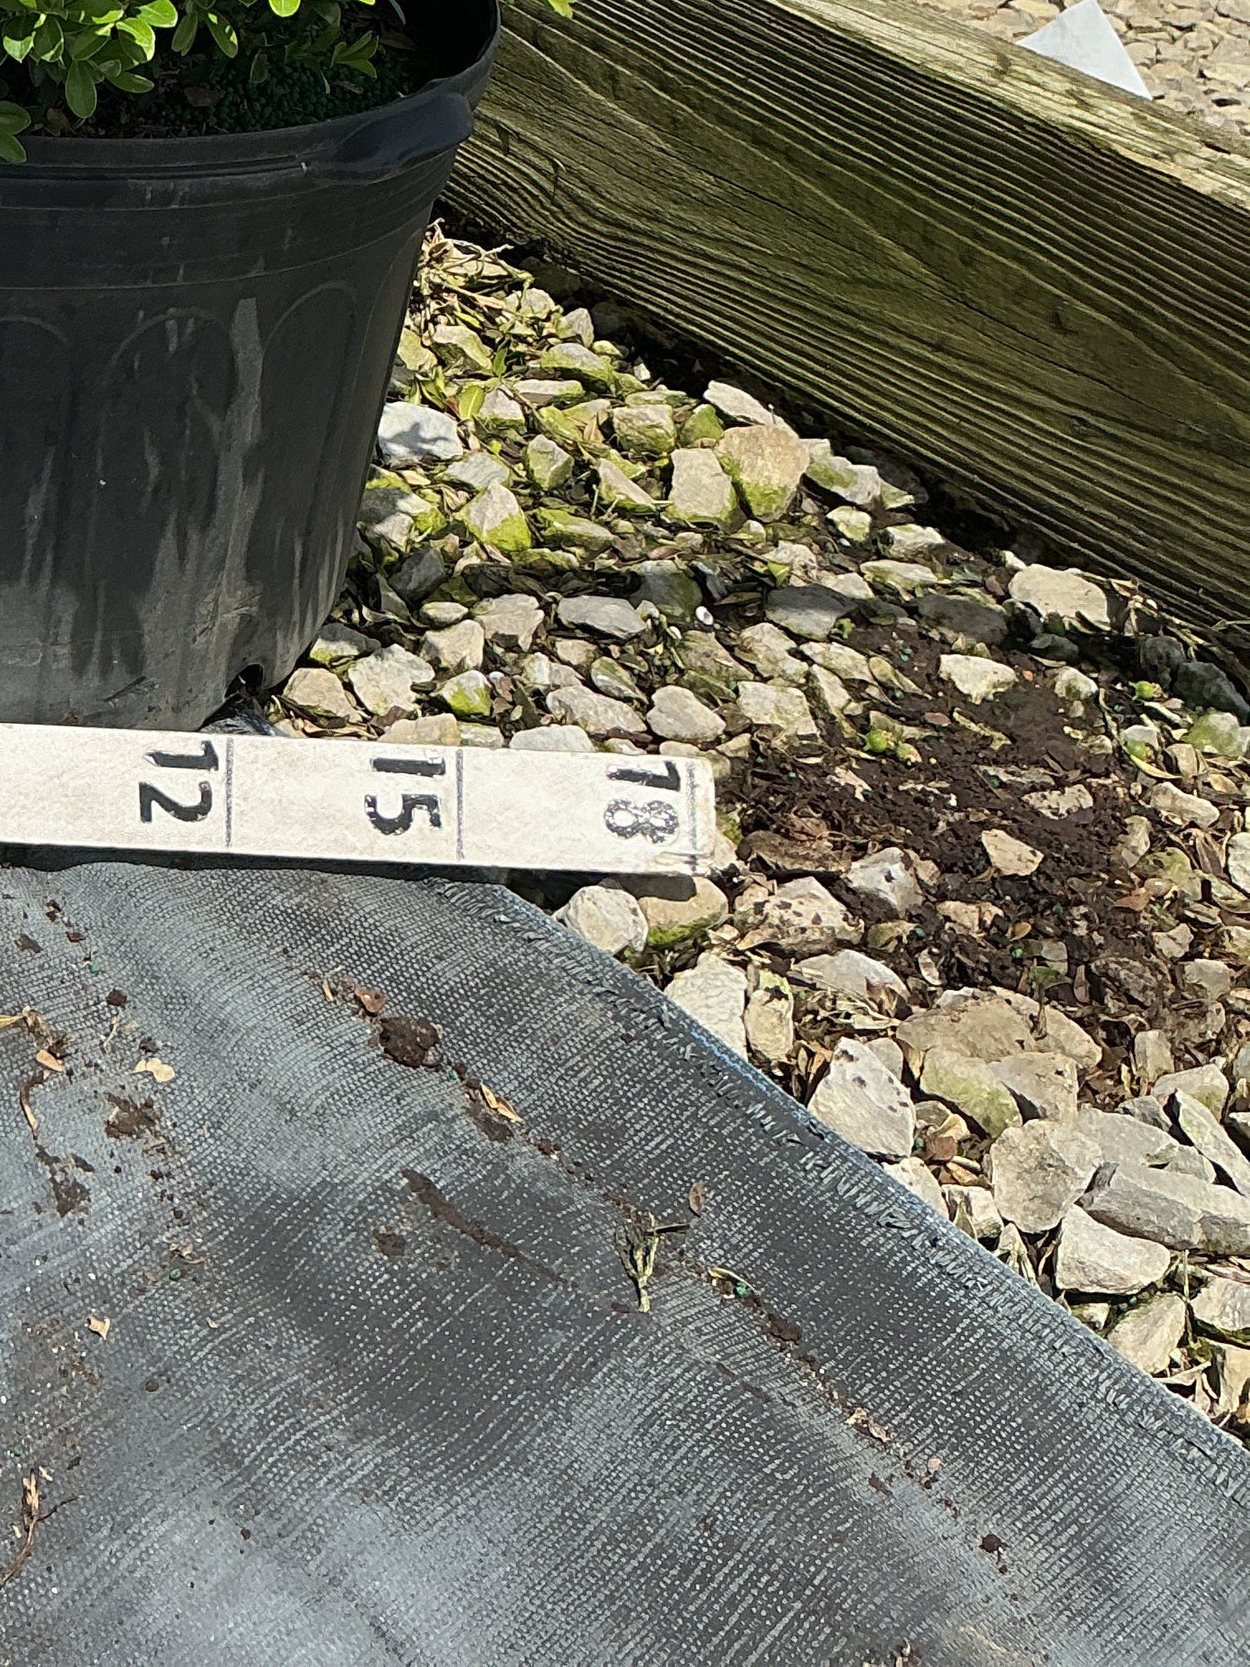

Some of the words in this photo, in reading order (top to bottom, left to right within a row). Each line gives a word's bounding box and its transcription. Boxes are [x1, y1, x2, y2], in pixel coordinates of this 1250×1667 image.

[137, 740, 219, 823] 12
[363, 751, 448, 836] 15
[604, 760, 681, 844] 18
